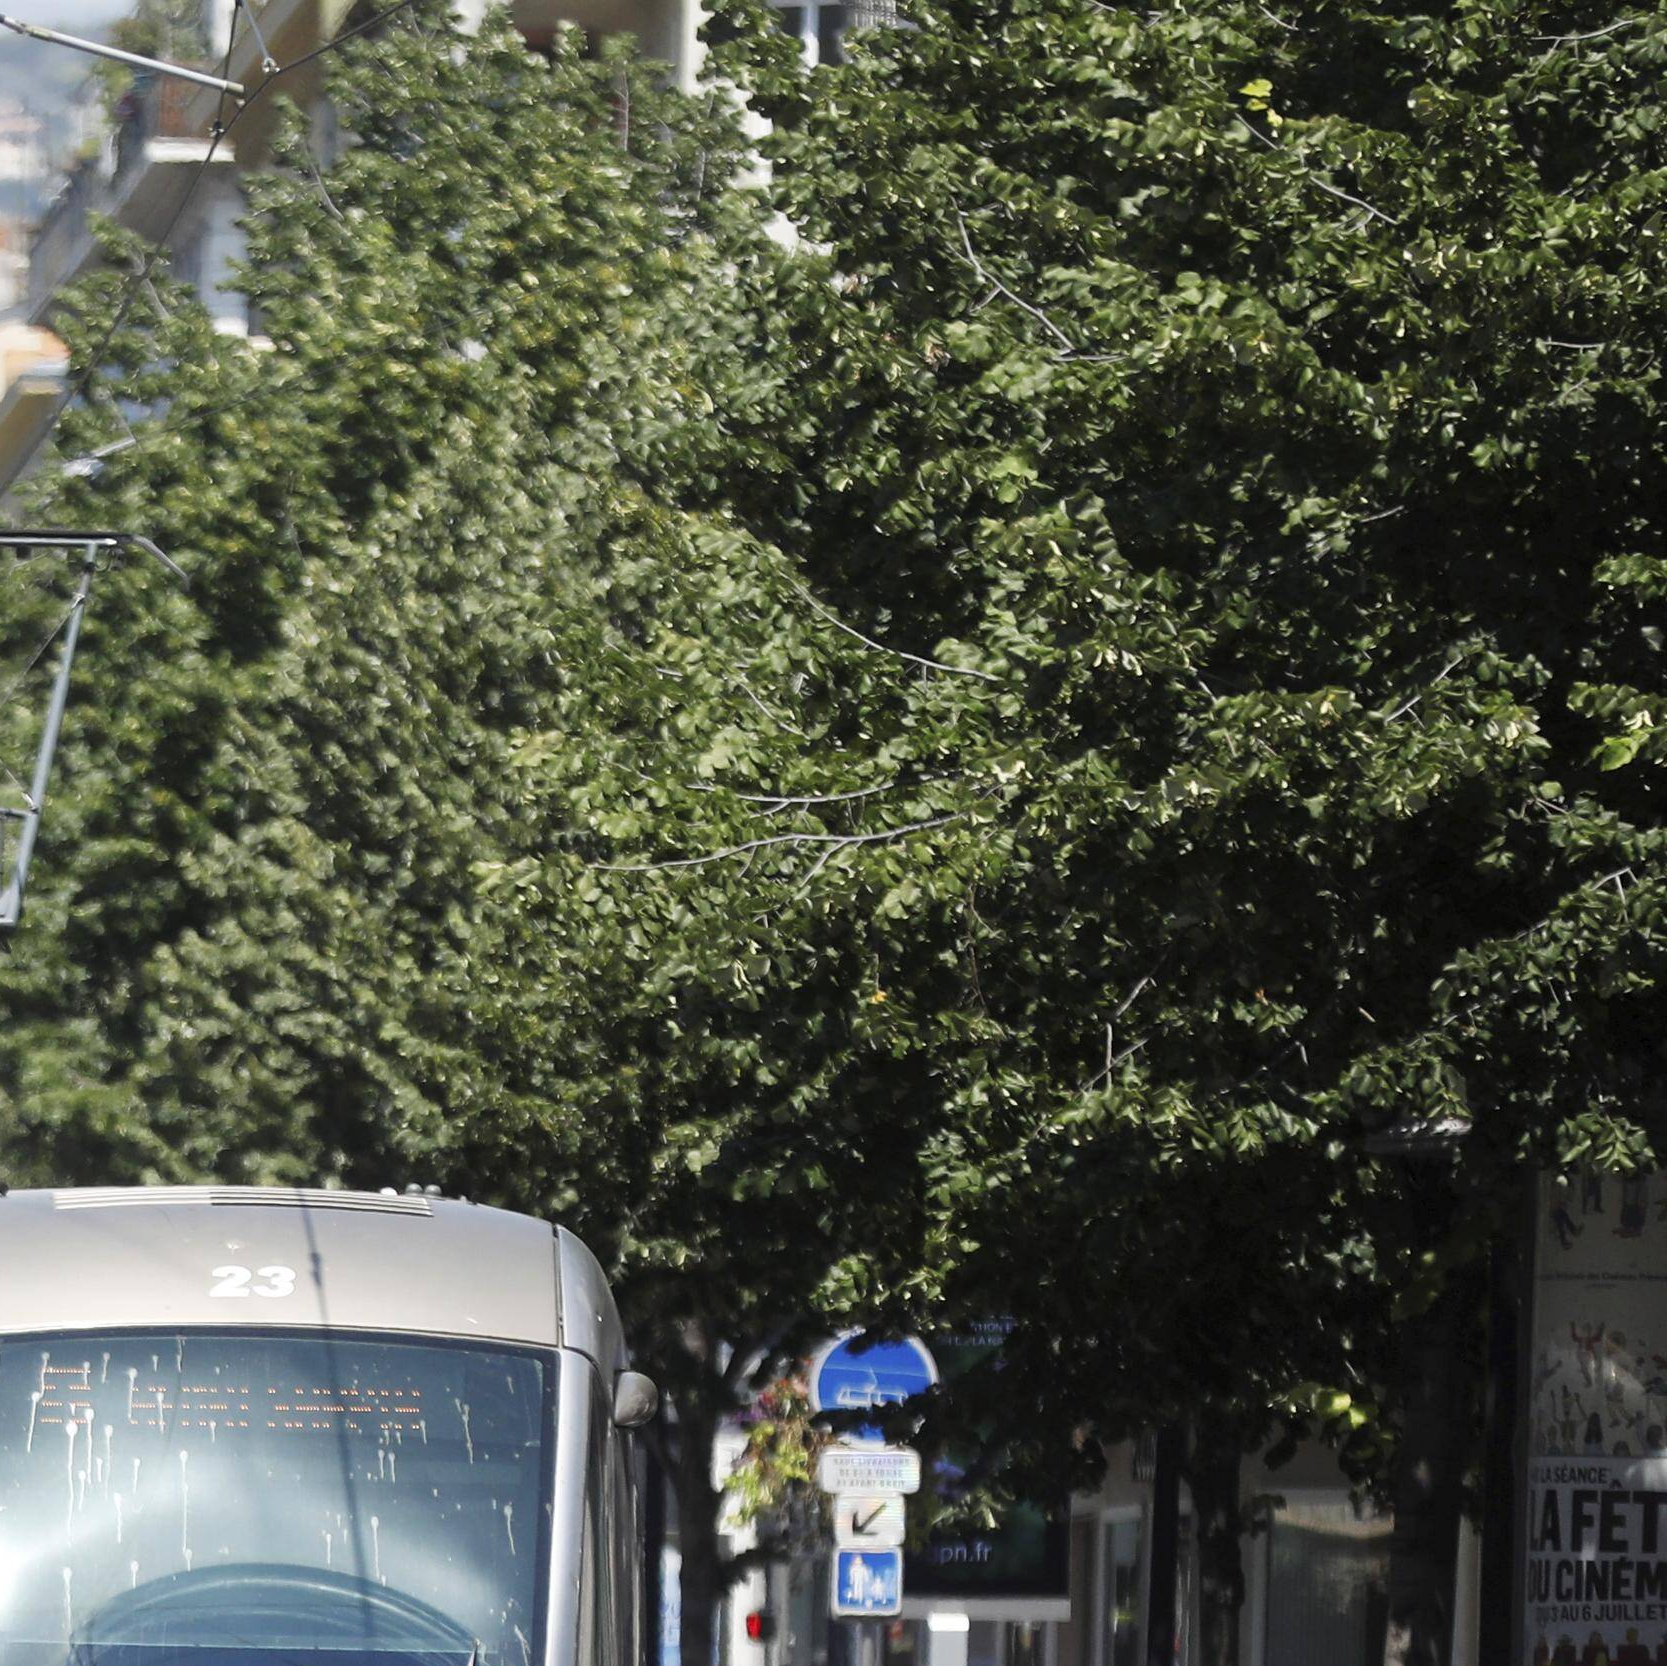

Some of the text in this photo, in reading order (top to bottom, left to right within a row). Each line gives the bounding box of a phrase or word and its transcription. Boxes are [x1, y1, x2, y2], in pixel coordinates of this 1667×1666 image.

[210, 1265, 296, 1298] 23
[1554, 1464, 1607, 1484] SÉANCE
[1529, 1489, 1562, 1552] LA
[1528, 1559, 1550, 1603] DU
[1561, 1606, 1579, 1622] AU
[1582, 1605, 1591, 1622] 6
[1594, 1604, 1667, 1621] JUILLET
